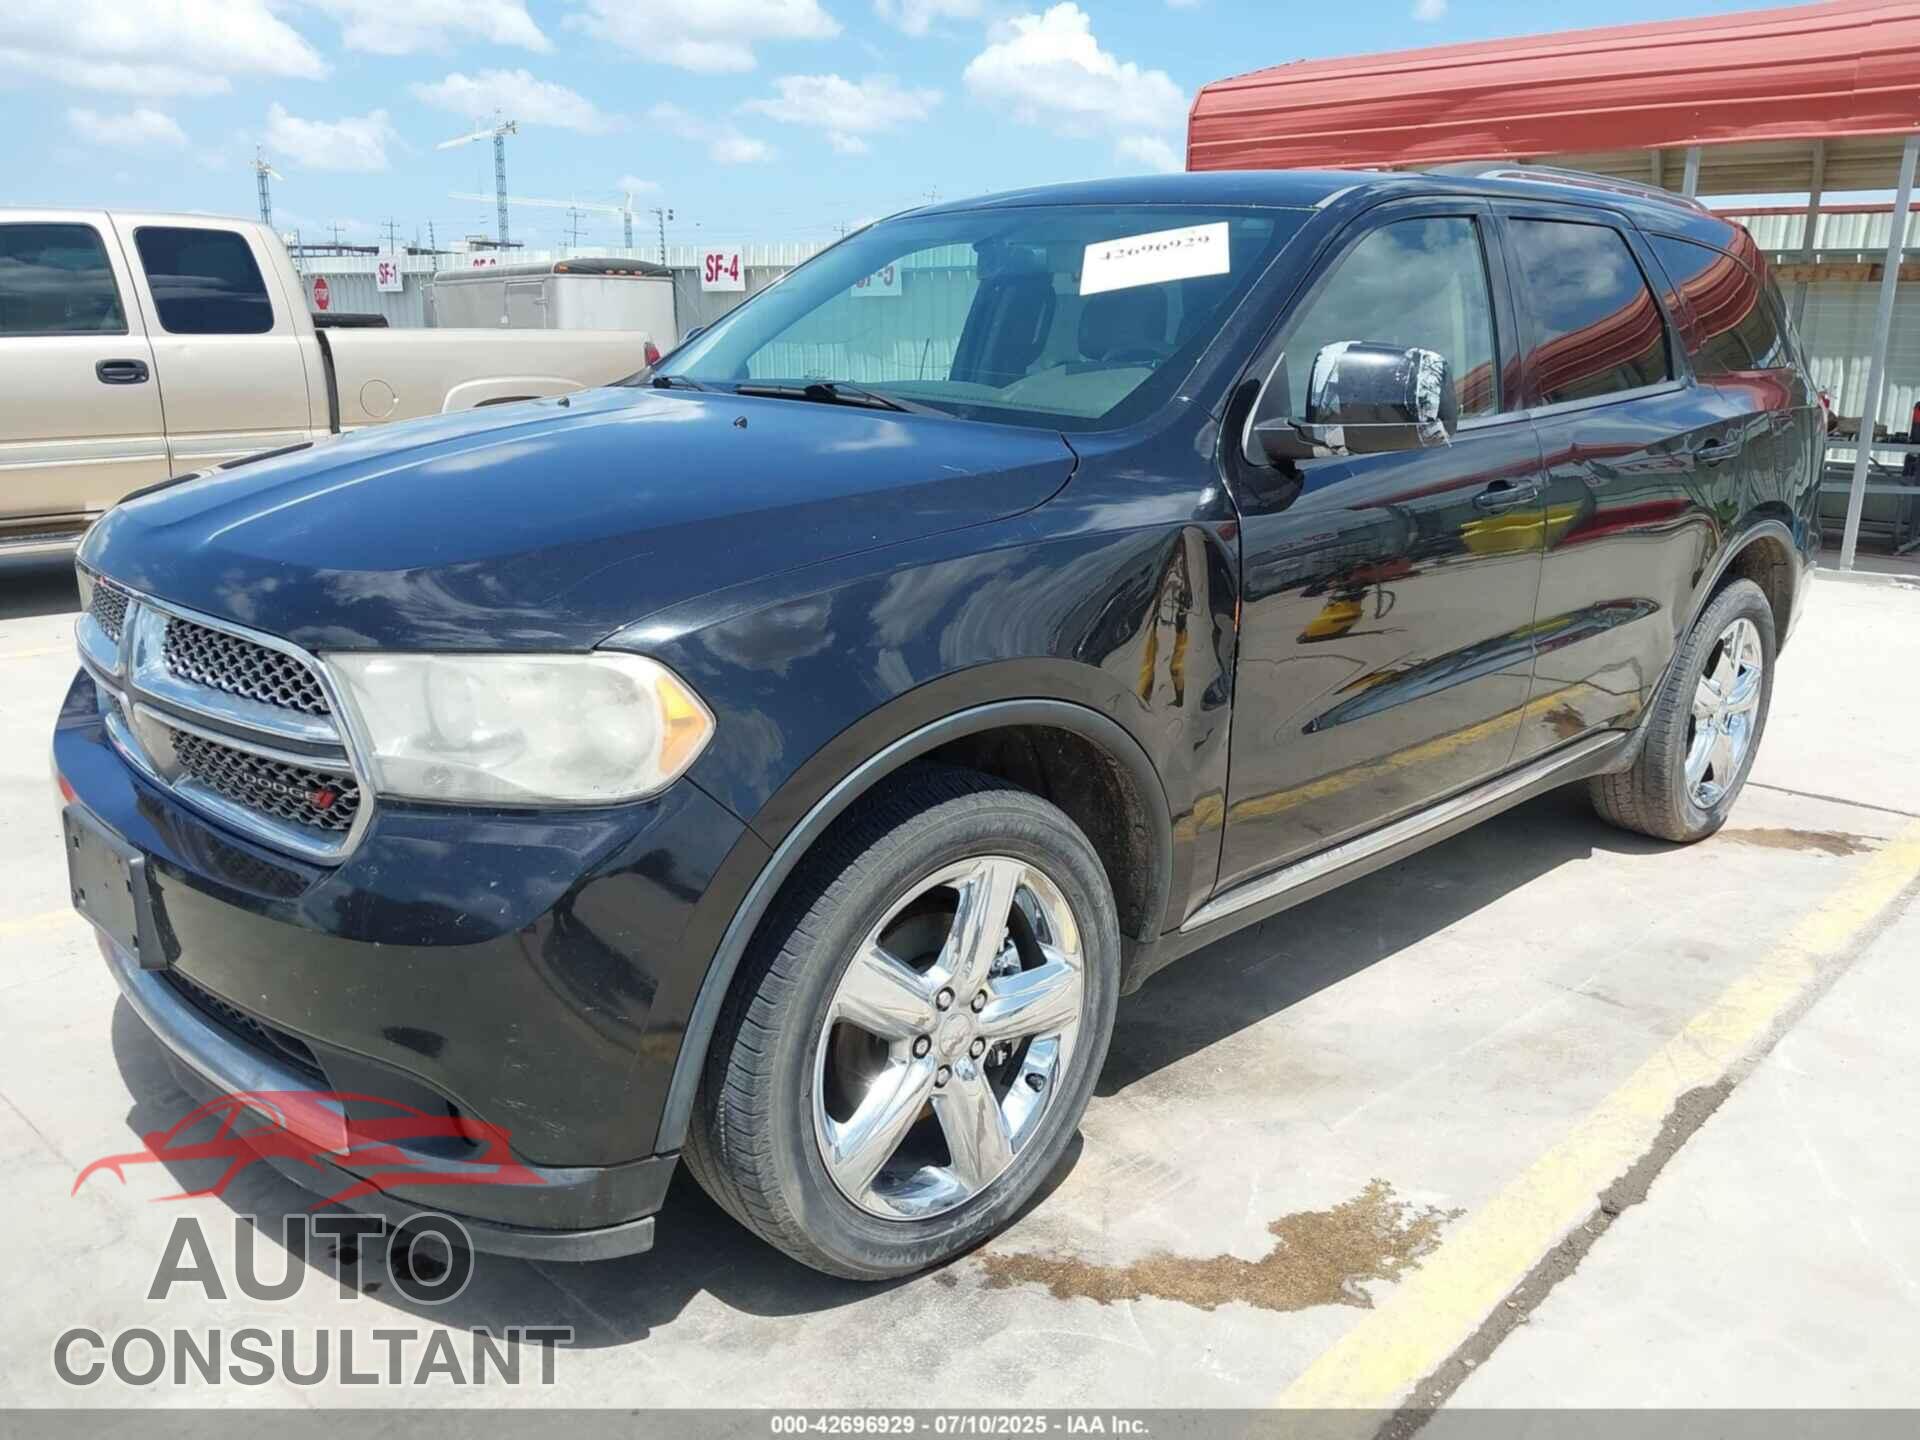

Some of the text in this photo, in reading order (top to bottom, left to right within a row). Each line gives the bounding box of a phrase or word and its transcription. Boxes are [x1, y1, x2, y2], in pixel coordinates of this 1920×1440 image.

[378, 263, 398, 285] SF-1
[705, 254, 739, 282] SF-4
[314, 287, 329, 299] STOP
[243, 772, 319, 804] DODGE
